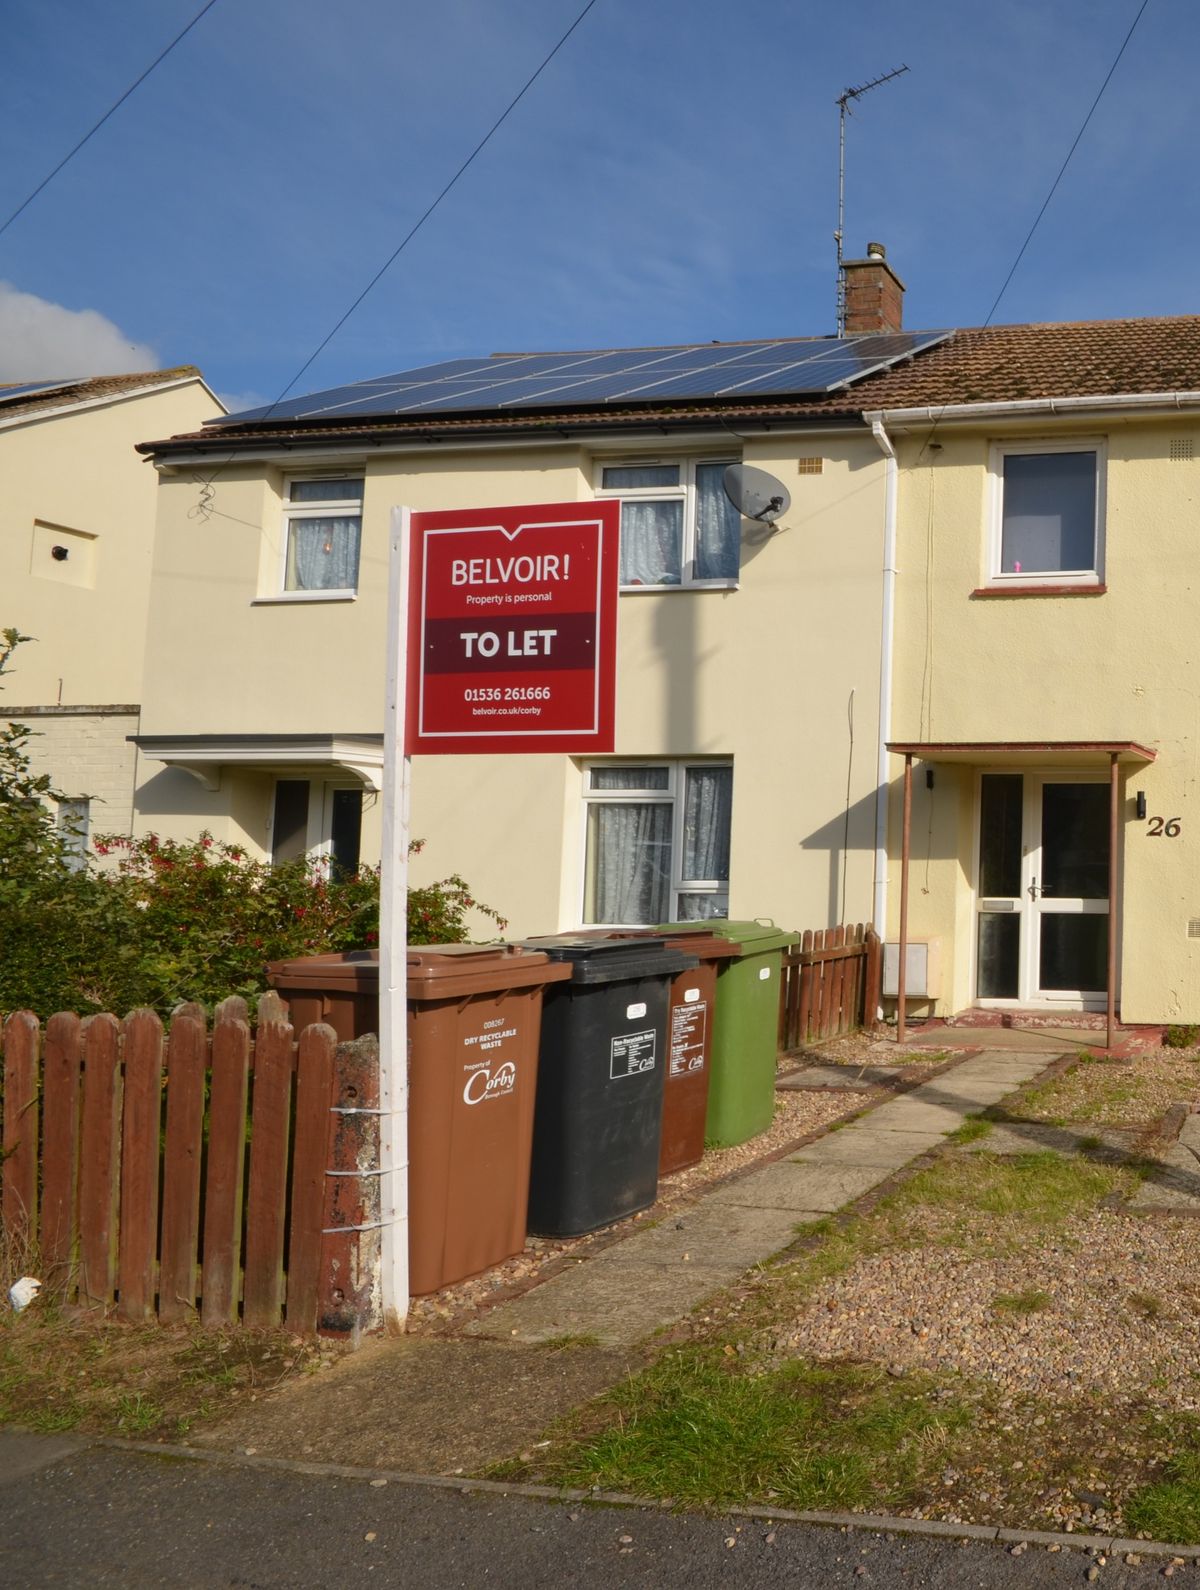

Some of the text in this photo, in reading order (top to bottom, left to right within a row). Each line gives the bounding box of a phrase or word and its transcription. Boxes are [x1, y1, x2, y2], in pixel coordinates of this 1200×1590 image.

[451, 554, 570, 586] BELVOIR!
[466, 592, 552, 606] Property is personal
[460, 629, 557, 657] TO LET
[464, 686, 550, 702] 01536 261666
[472, 705, 541, 716] belvoir.co.uk/corby
[1146, 816, 1181, 838] 26
[464, 1029, 517, 1046] DRY RECYCLABLE
[480, 1040, 502, 1050] WASTE
[464, 1061, 516, 1105] Corby
